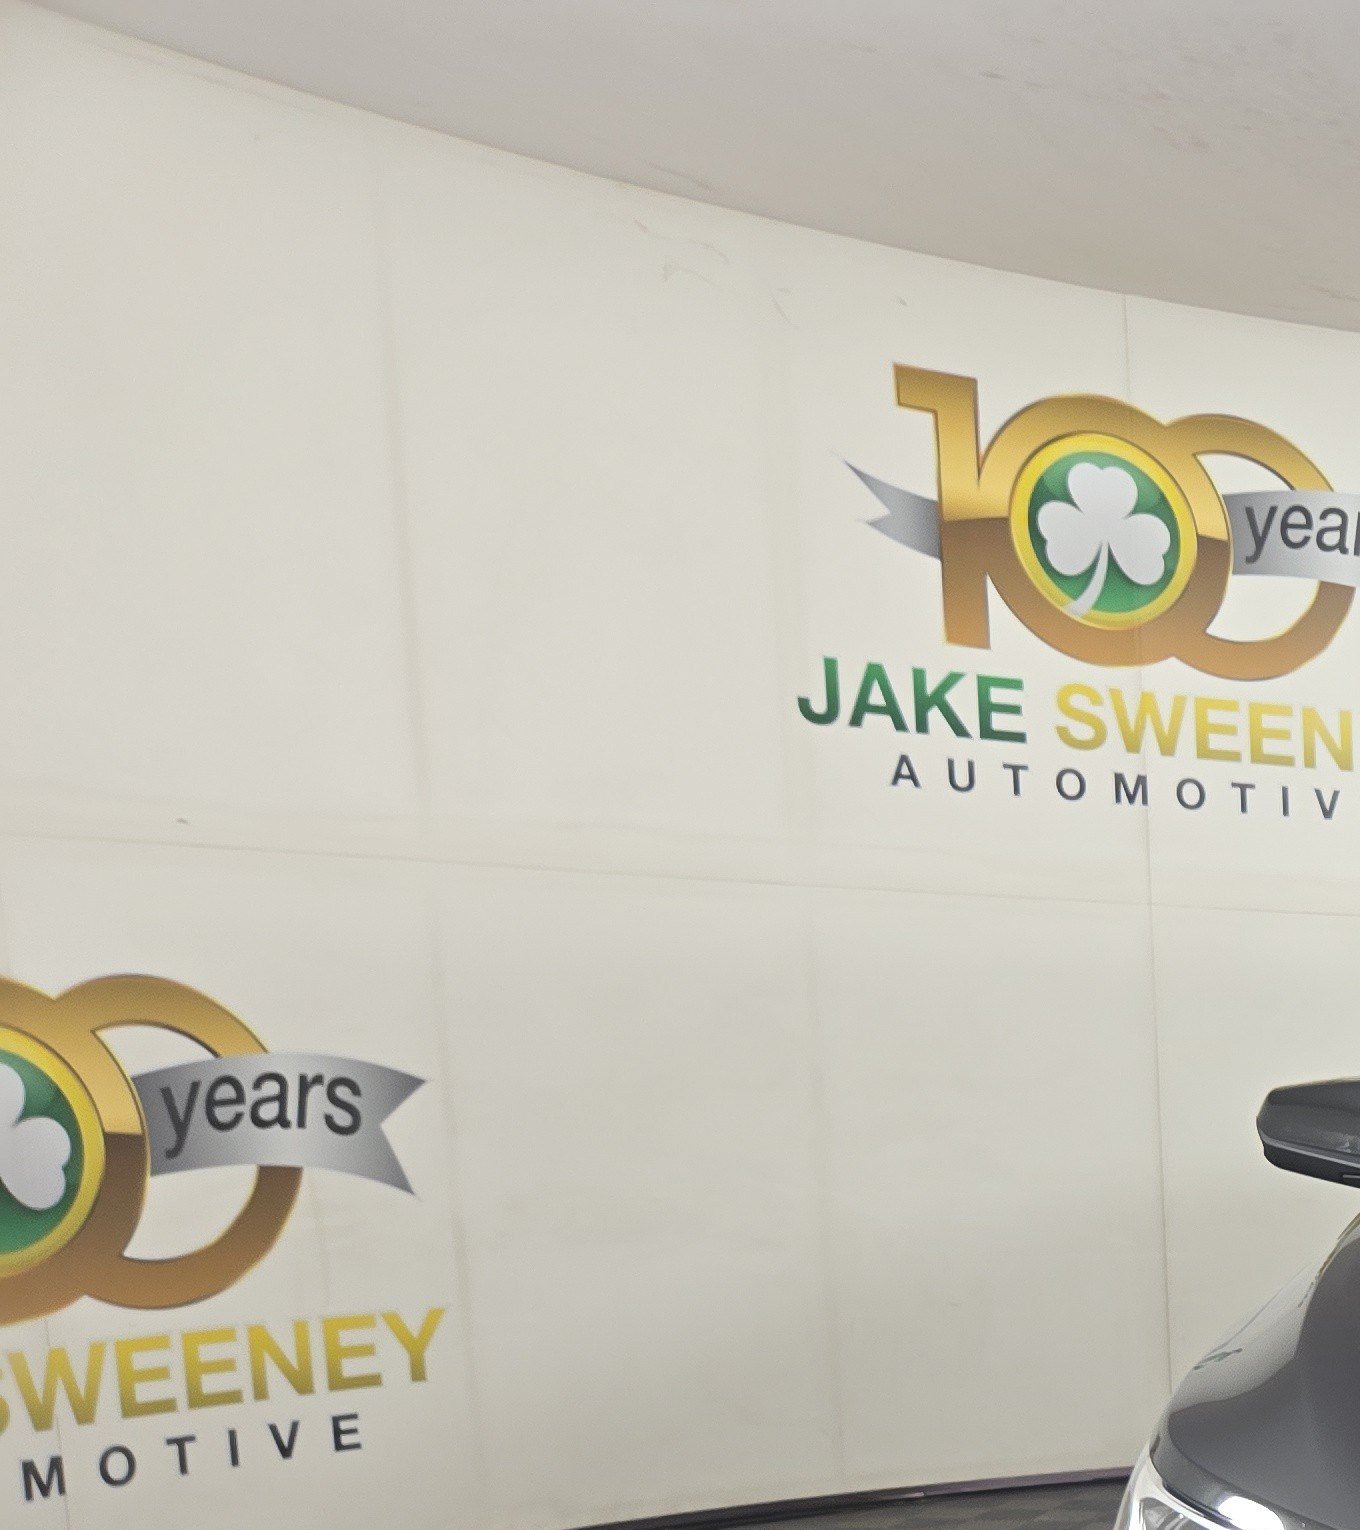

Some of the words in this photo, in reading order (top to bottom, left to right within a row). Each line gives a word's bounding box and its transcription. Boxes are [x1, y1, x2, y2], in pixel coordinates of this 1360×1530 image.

[893, 362, 1356, 681] 100
[797, 656, 1027, 744] JAKE
[160, 1071, 362, 1159] years
[0, 1308, 446, 1436] WEENEY
